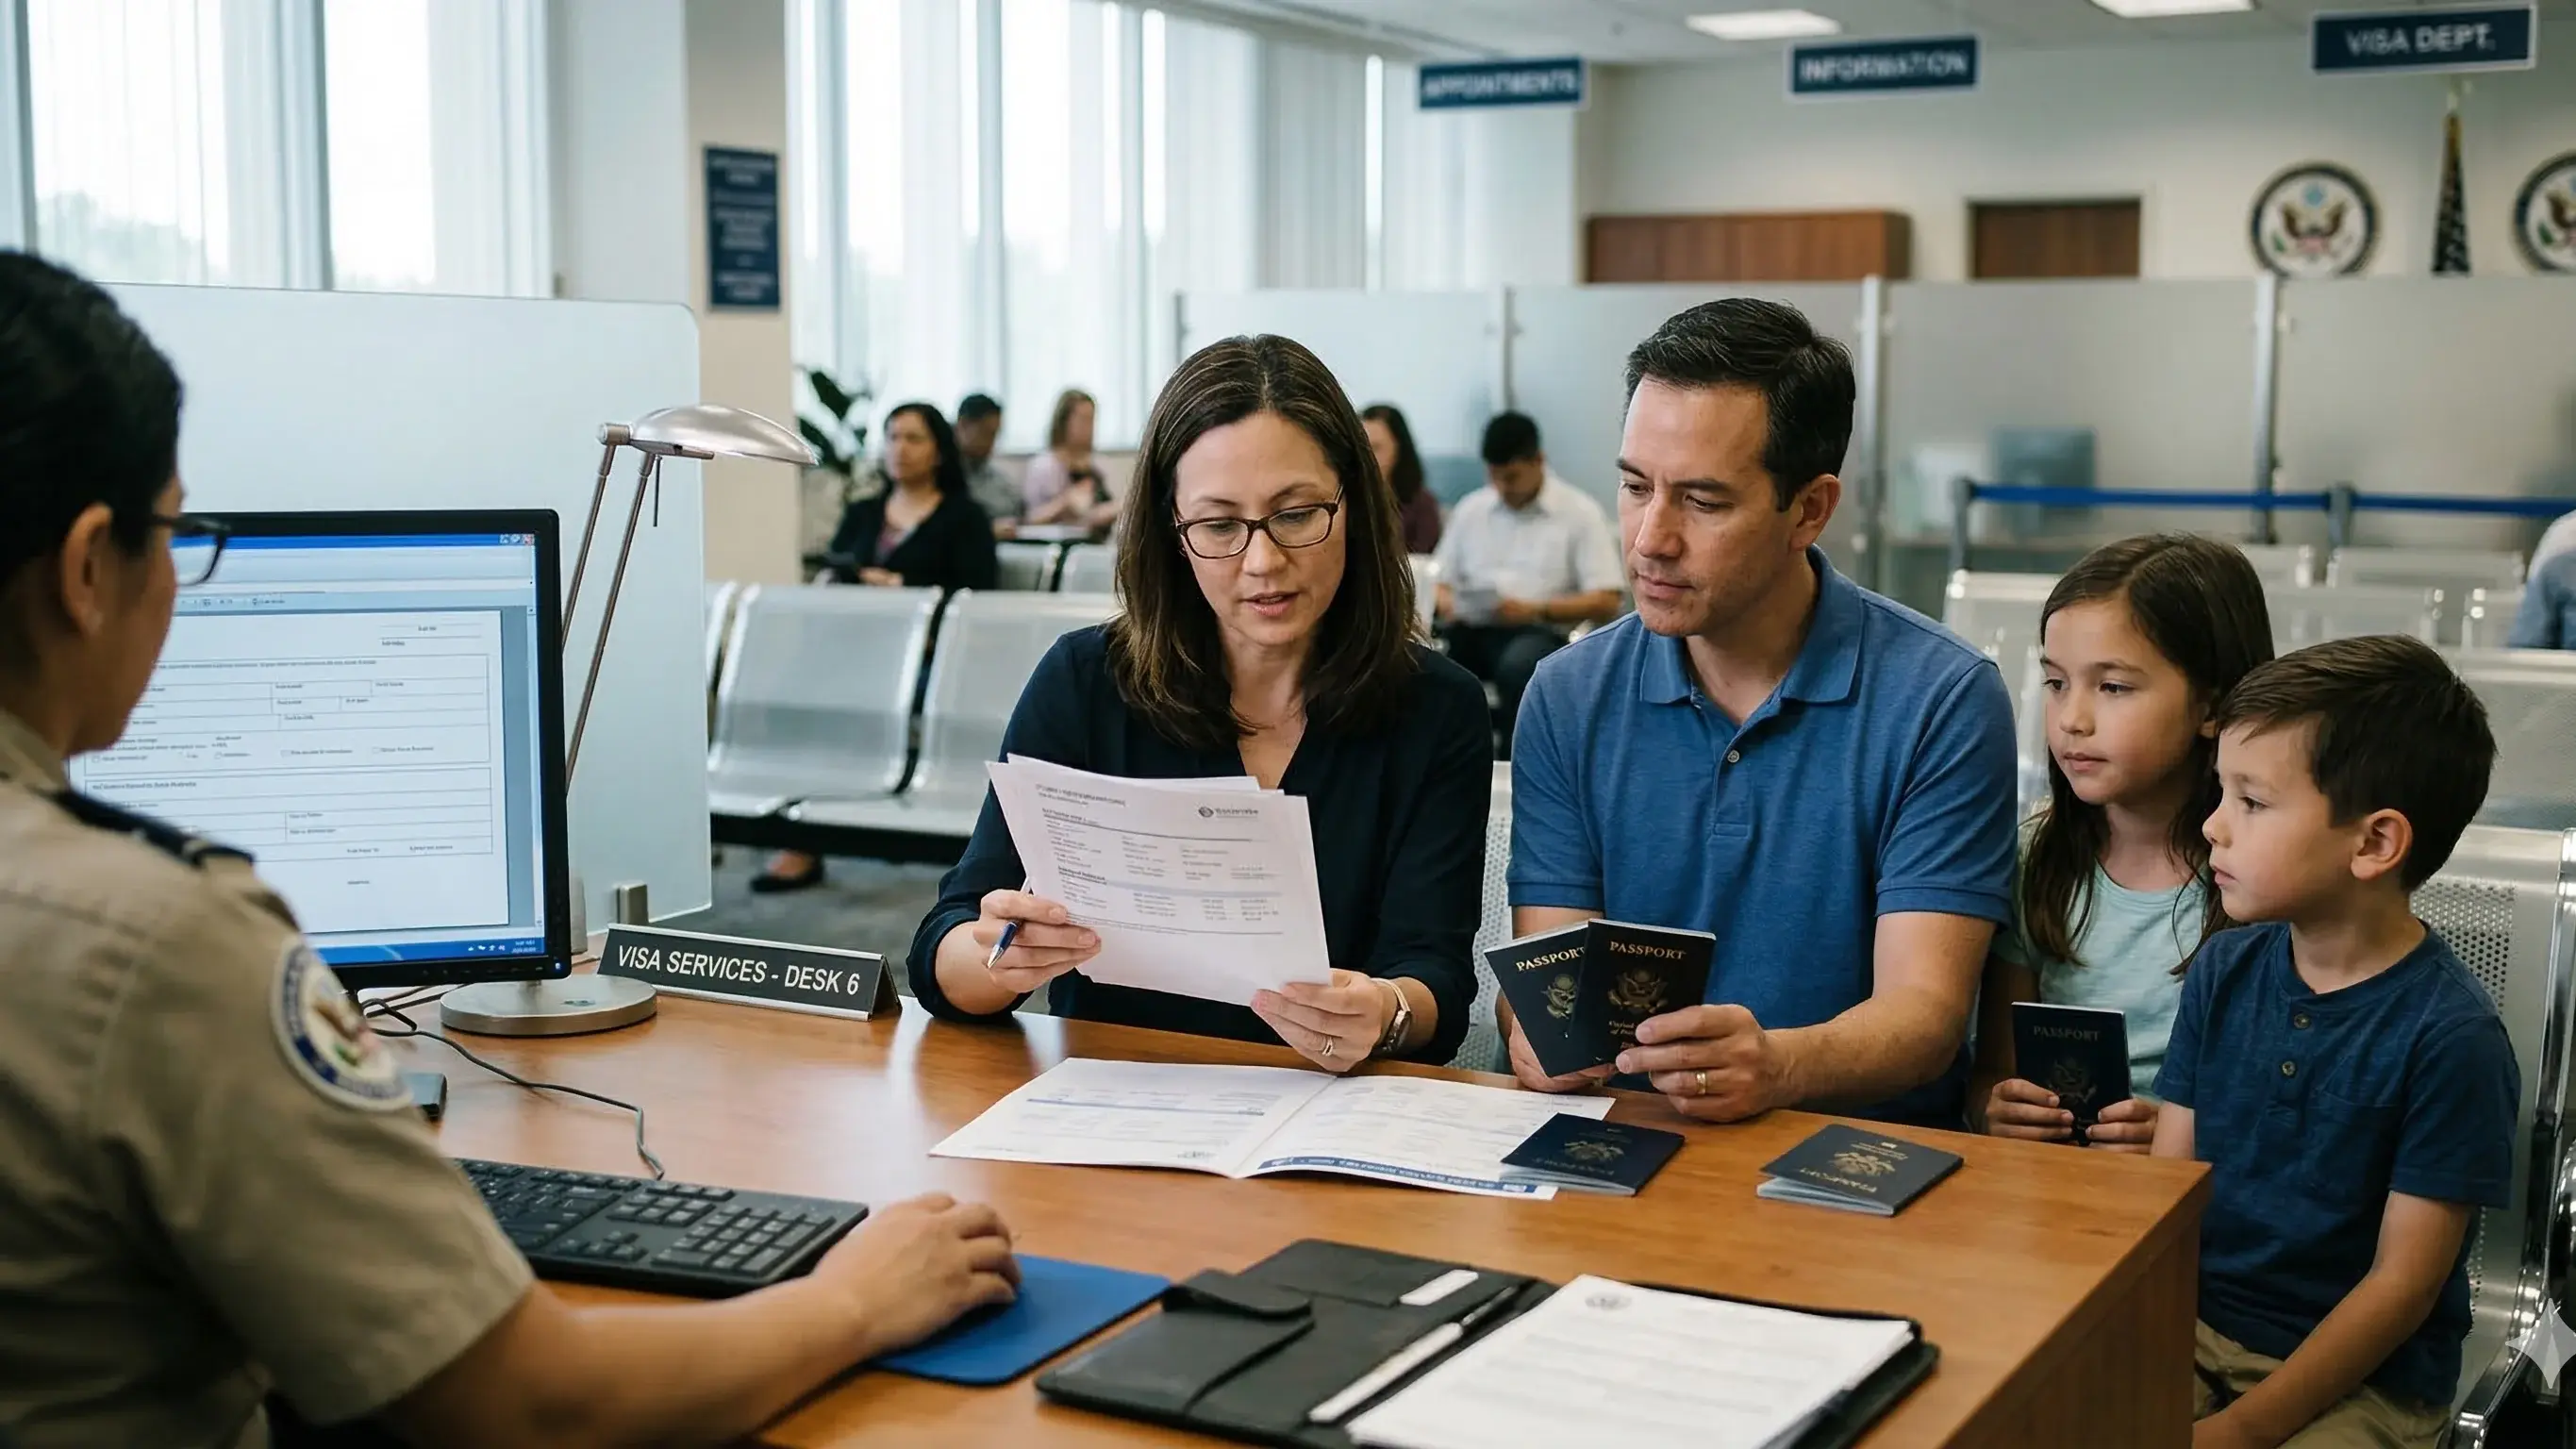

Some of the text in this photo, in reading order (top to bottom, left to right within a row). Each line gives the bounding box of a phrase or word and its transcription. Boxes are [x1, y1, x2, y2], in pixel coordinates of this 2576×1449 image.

[2344, 27, 2410, 57] VISA
[1515, 945, 1586, 973] PASSPORT
[1609, 941, 1687, 961] PASSPORT
[619, 944, 661, 972] VISA
[666, 951, 768, 984] SERVICES
[784, 964, 844, 994] DESK
[846, 973, 861, 996] 6
